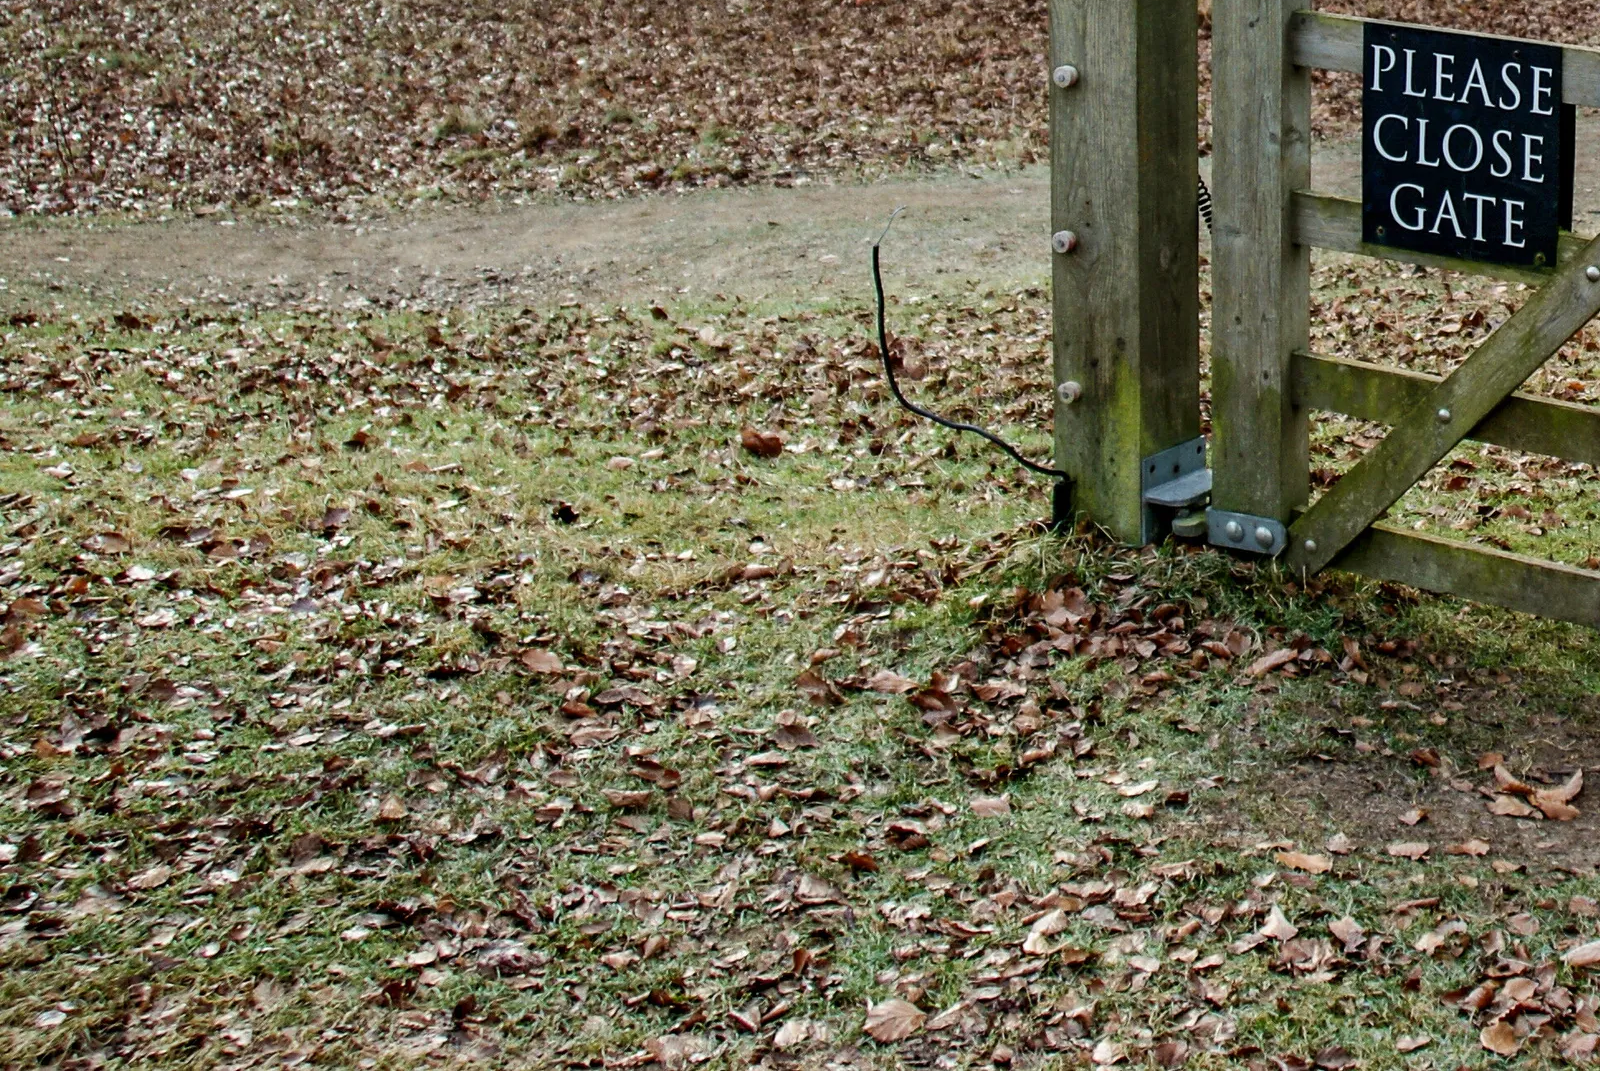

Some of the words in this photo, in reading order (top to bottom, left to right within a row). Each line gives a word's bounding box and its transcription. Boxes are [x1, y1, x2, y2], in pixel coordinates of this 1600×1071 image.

[1370, 44, 1553, 116] PLEASE
[1373, 113, 1545, 184] CLOSE
[1389, 183, 1526, 248] GATE
